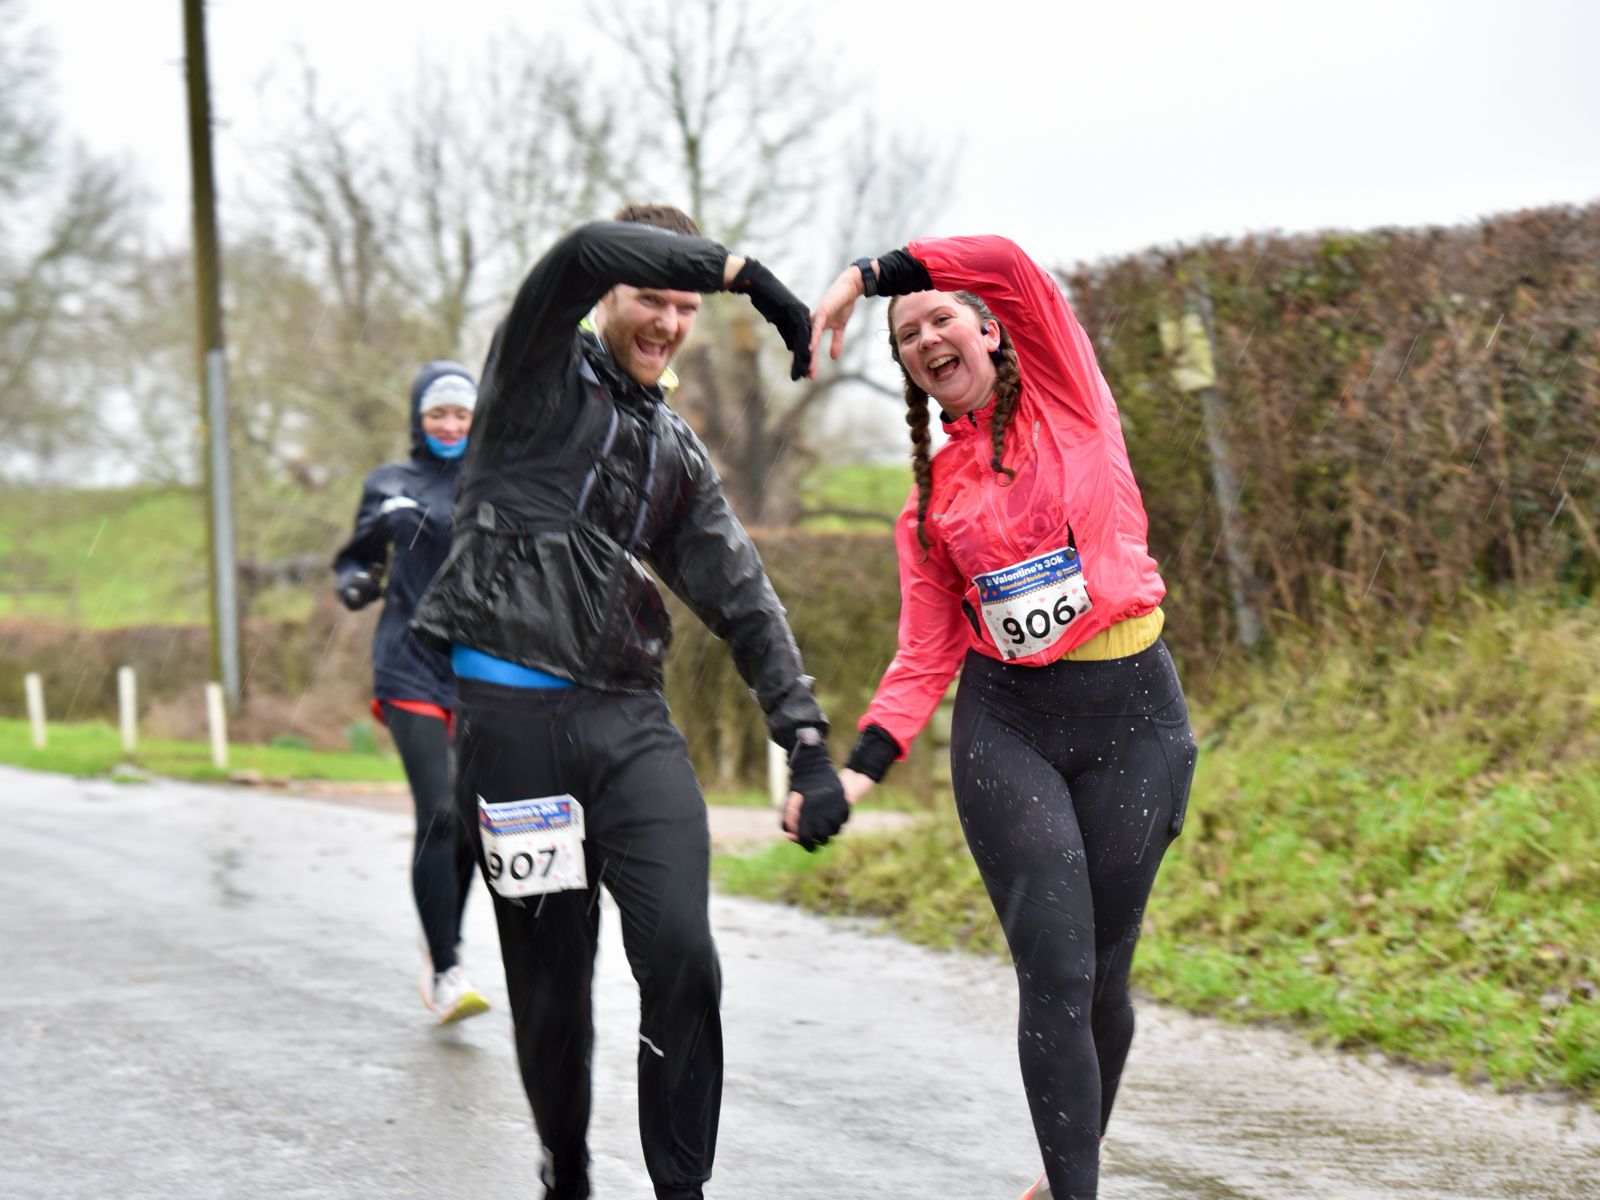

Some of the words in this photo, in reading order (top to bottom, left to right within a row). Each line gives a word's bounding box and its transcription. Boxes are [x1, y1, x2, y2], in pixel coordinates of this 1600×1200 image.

[992, 563, 1043, 585] Valentine's
[1002, 595, 1076, 645] 906
[488, 846, 556, 880] 907
